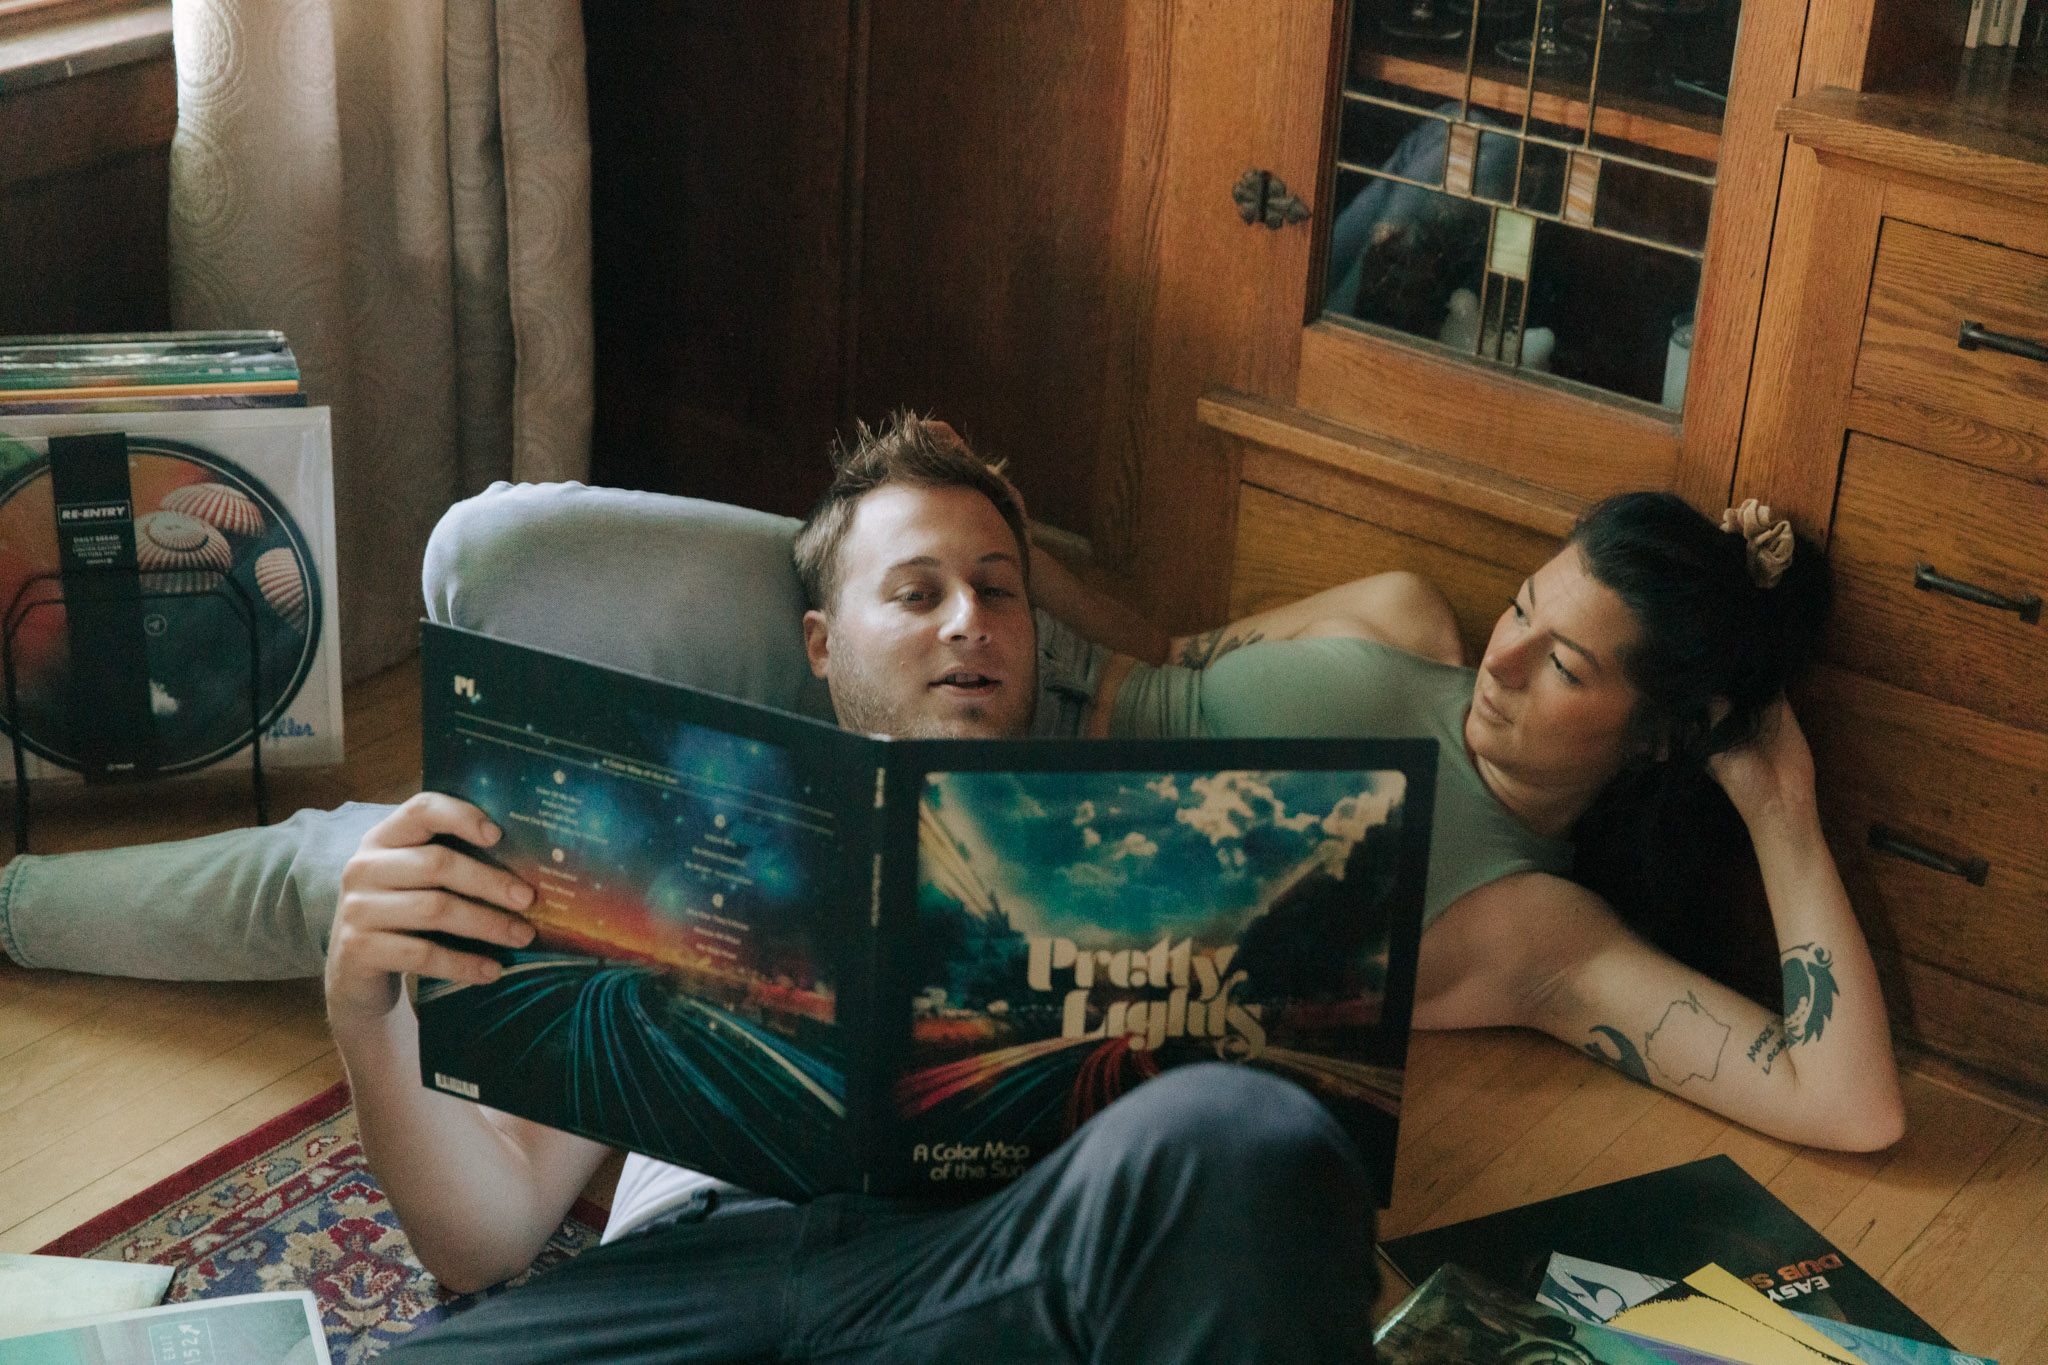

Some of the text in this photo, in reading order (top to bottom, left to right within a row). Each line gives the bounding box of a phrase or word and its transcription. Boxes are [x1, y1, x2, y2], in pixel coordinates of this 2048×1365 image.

[62, 506, 125, 519] RE-ENTRY
[1027, 934, 1240, 1000] Pretty
[1061, 970, 1267, 1060] Lights
[913, 1141, 1030, 1162] A Color Map
[930, 1161, 952, 1180] of
[954, 1161, 987, 1180] the
[1777, 1253, 1844, 1282] DUB
[1767, 1275, 1831, 1302] EASY
[160, 1335, 176, 1361] EXIT
[182, 1336, 201, 1365] 152
